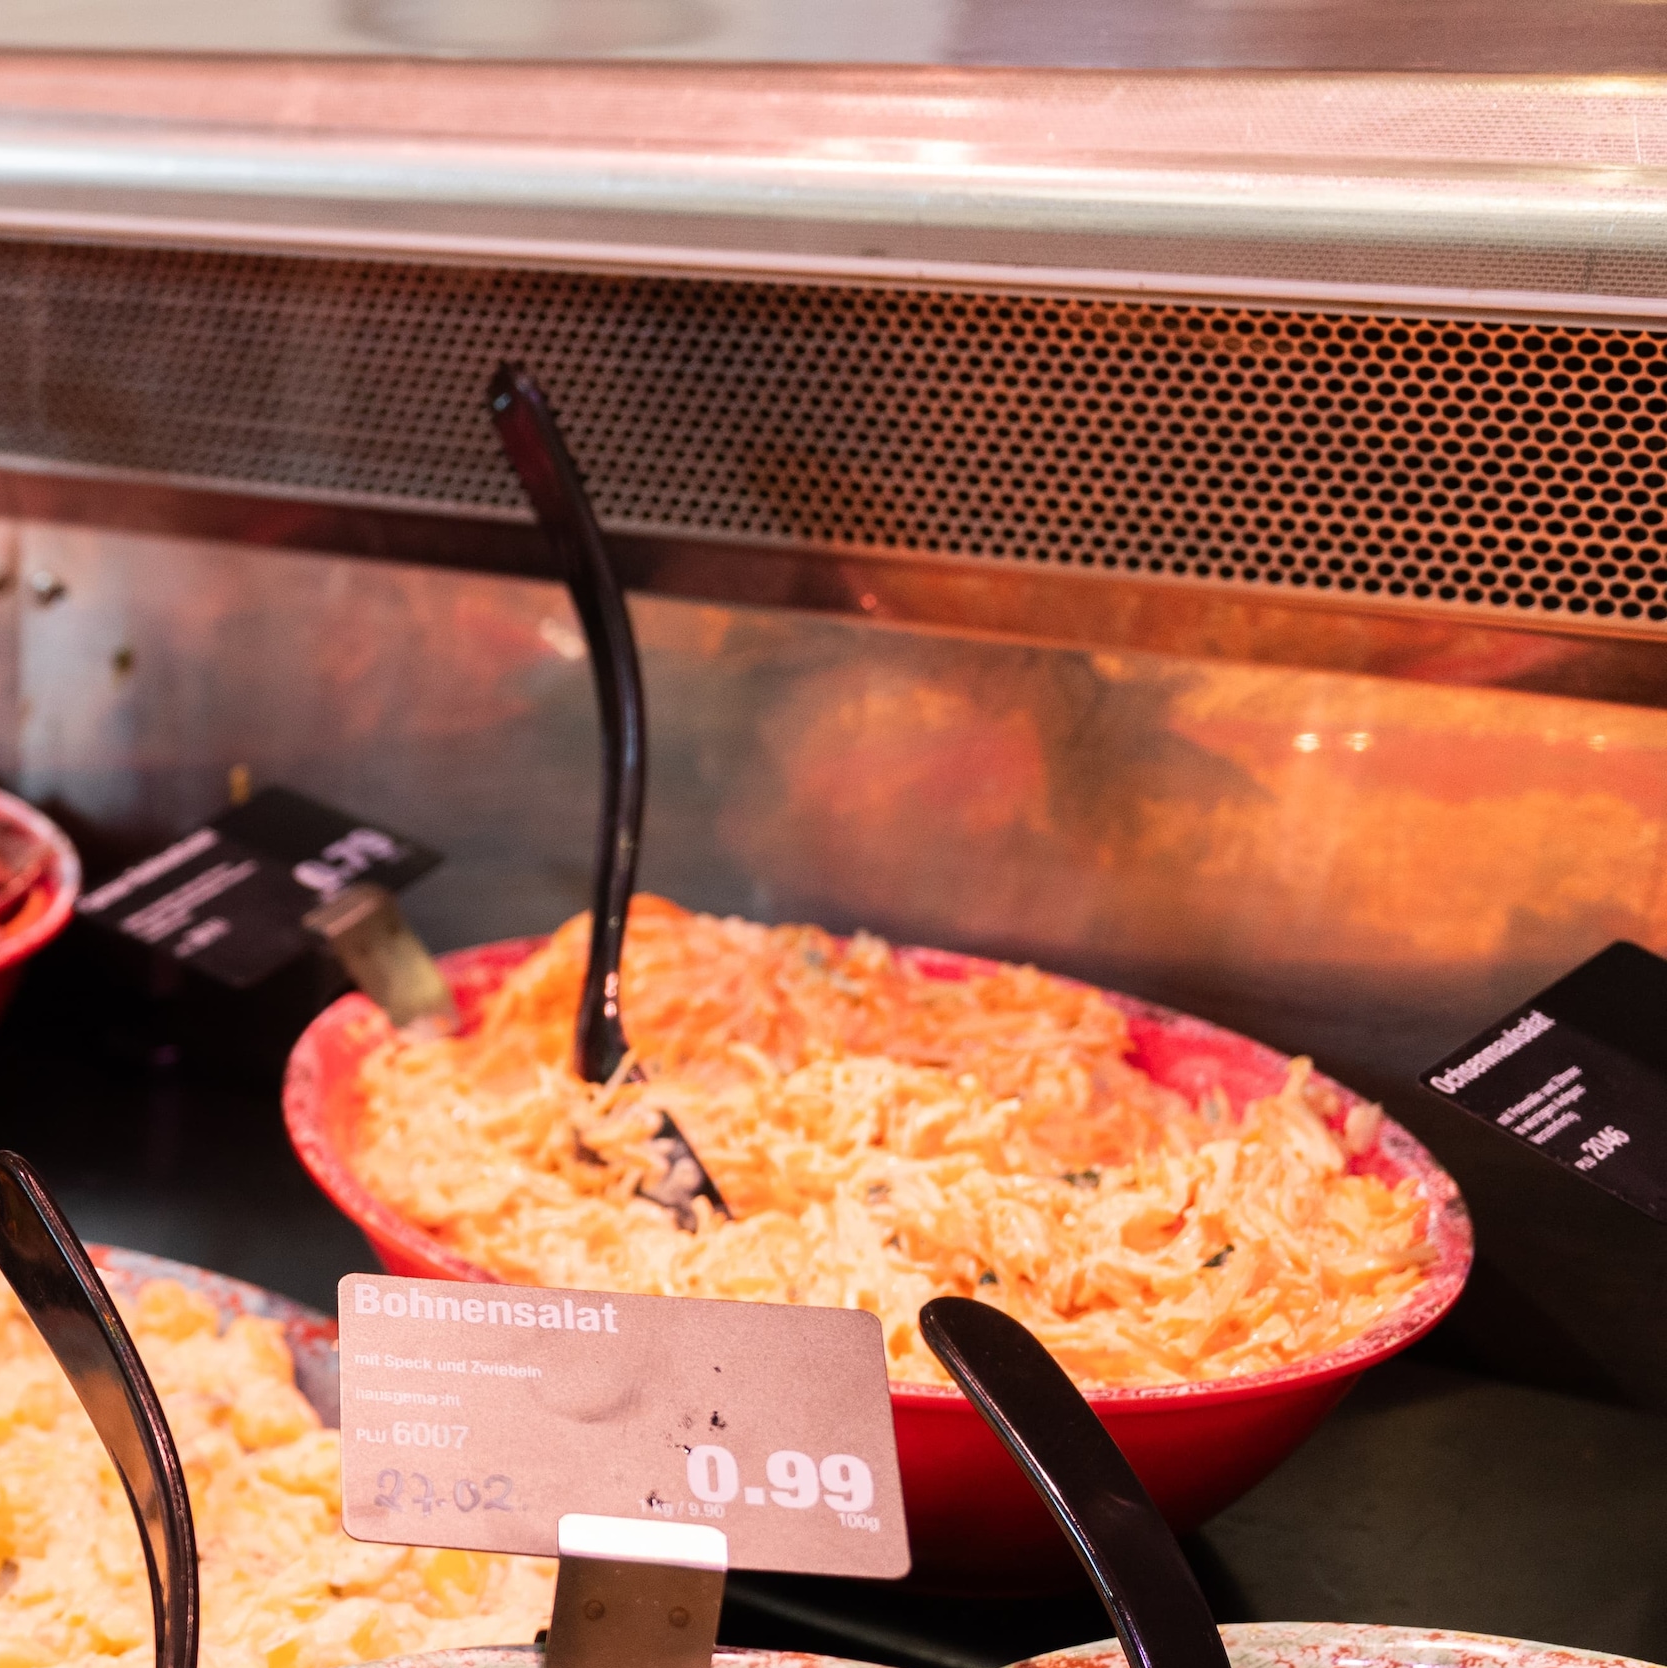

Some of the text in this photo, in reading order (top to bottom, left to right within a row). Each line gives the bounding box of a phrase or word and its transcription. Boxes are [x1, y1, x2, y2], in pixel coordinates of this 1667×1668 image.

[1430, 1010, 1556, 1095] Ochsenmaulsalat
[1580, 1125, 1630, 1161] 2046
[354, 1283, 618, 1334] Bohnensalat
[354, 1353, 542, 1378] mit Speck und Zwiebeln
[356, 1420, 470, 1449] PLU 6007
[686, 1444, 874, 1512] 0.99
[838, 1512, 880, 1532] 100g
